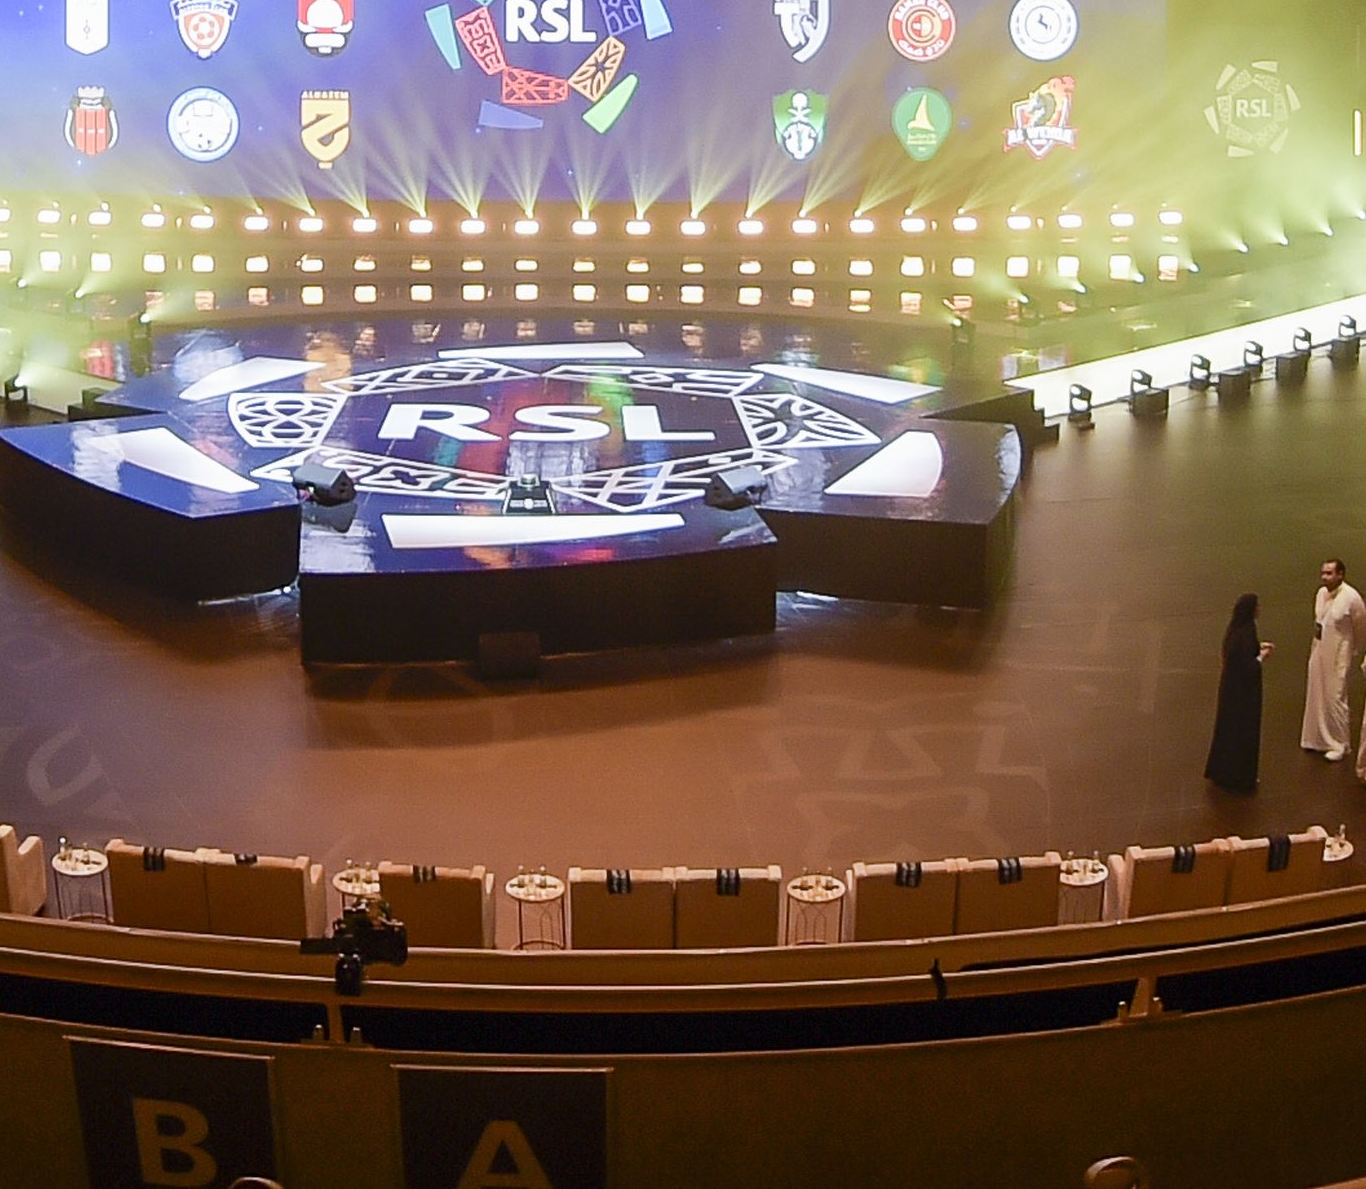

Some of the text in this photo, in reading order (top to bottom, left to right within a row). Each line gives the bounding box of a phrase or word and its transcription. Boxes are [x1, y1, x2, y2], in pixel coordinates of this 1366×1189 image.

[1235, 98, 1272, 117] RSL
[378, 404, 716, 442] RSL
[133, 1098, 218, 1188] B
[458, 1120, 554, 1189] A
